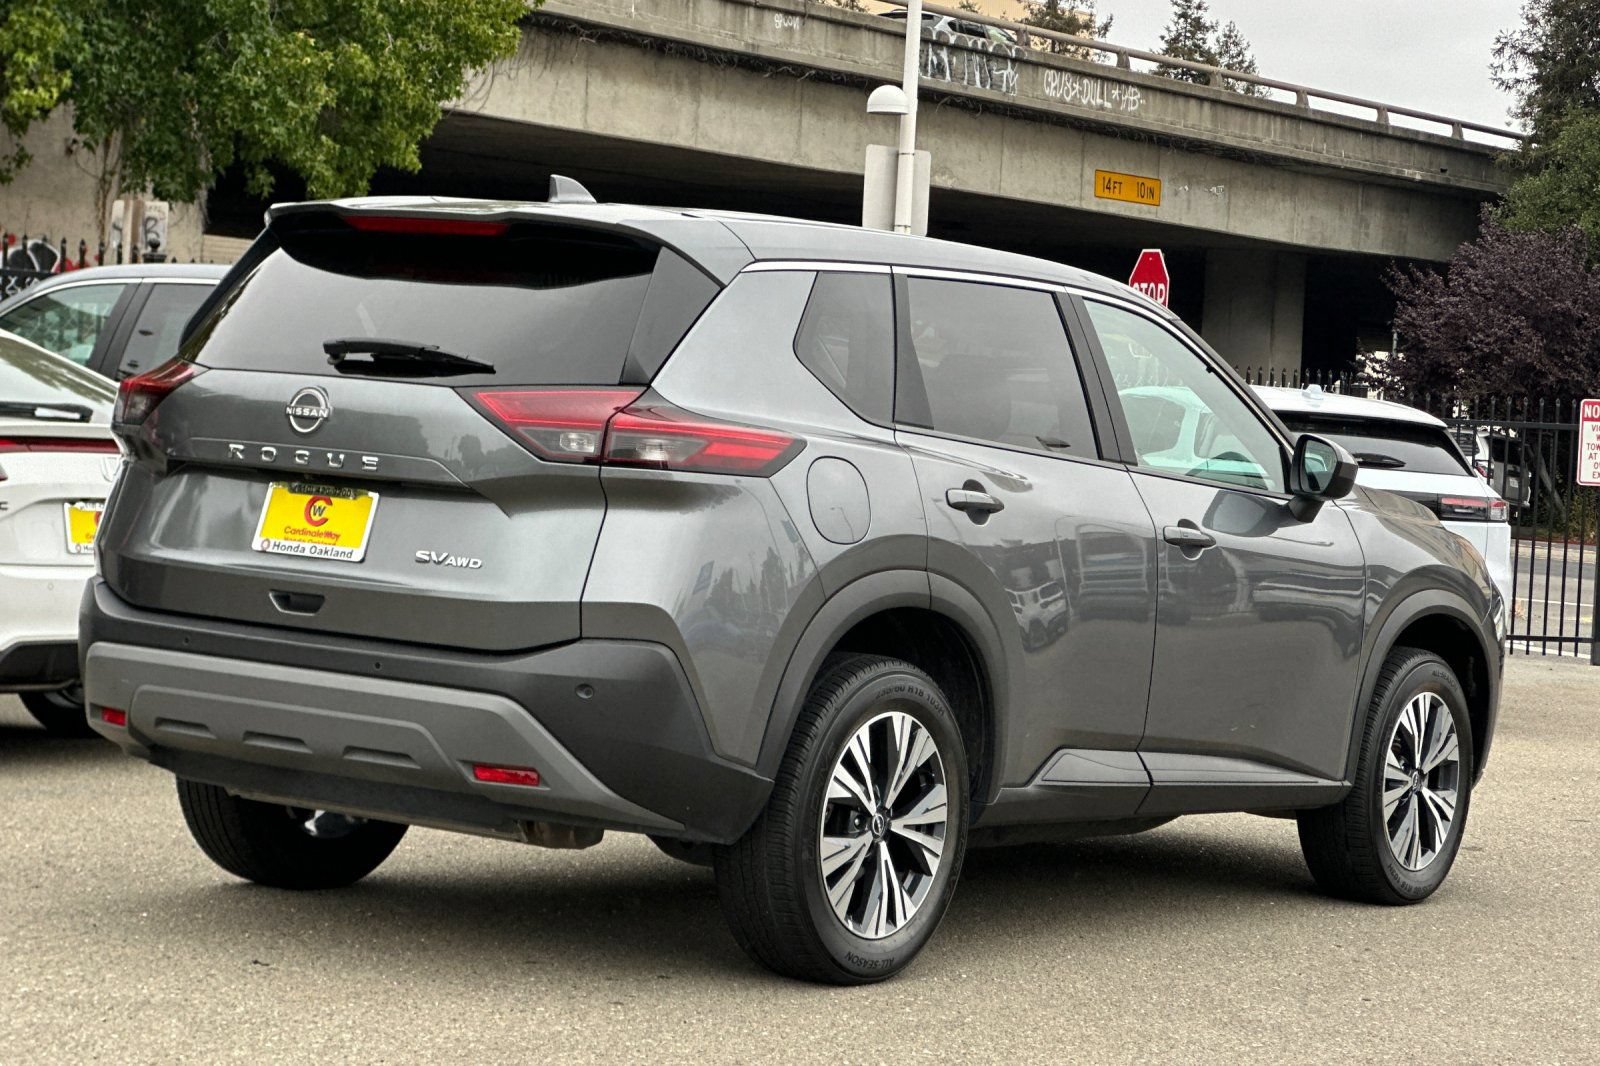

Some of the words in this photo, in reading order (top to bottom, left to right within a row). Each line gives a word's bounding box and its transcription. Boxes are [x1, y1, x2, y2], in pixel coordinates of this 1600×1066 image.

[285, 406, 330, 418] NISSAN
[1584, 404, 1600, 418] NO
[228, 443, 379, 471] ROGUE
[272, 541, 306, 555] Honda
[309, 545, 354, 559] Oakland
